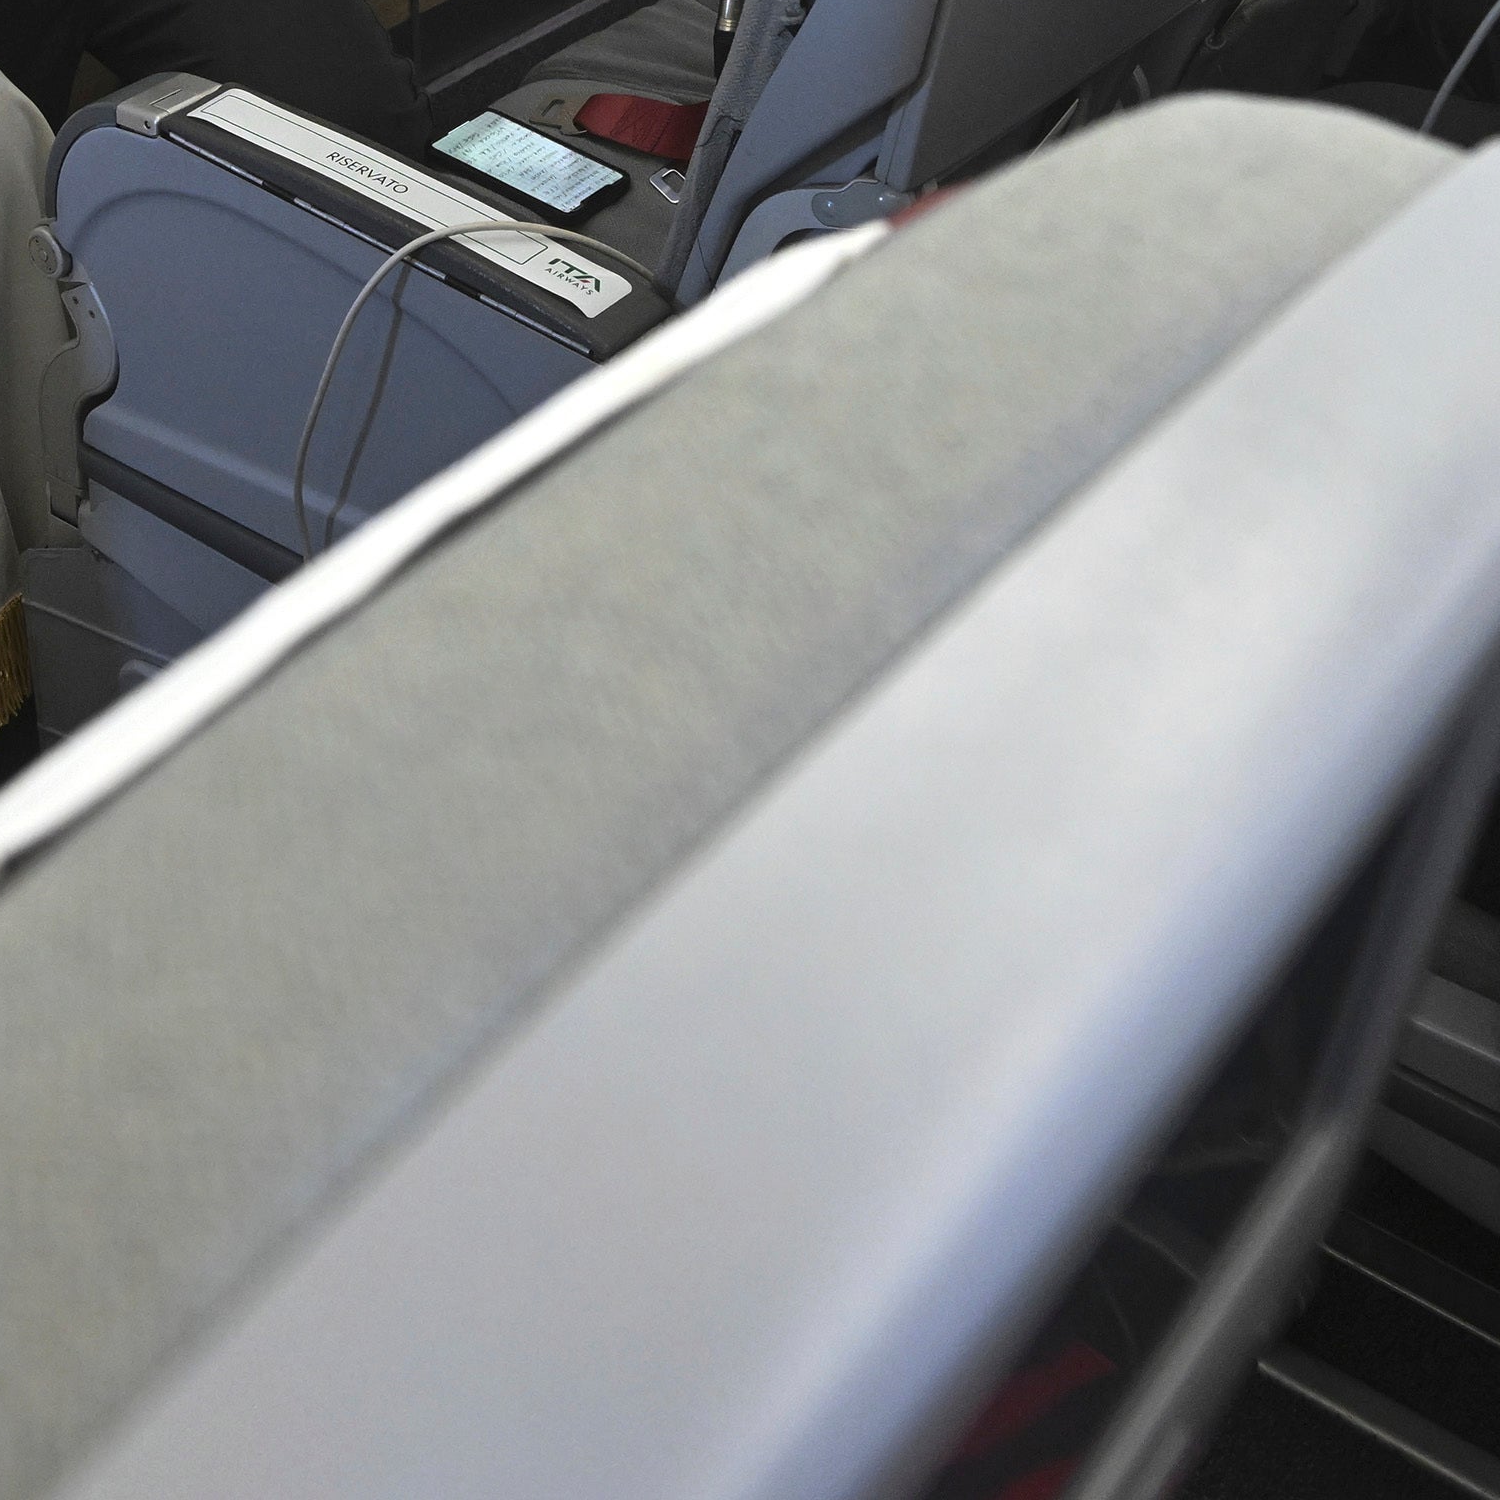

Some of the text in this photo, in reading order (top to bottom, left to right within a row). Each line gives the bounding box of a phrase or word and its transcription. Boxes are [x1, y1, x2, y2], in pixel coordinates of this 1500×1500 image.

[326, 151, 409, 194] RISERVATO
[544, 268, 593, 295] AIRWAYS
[548, 258, 601, 293] ITA
